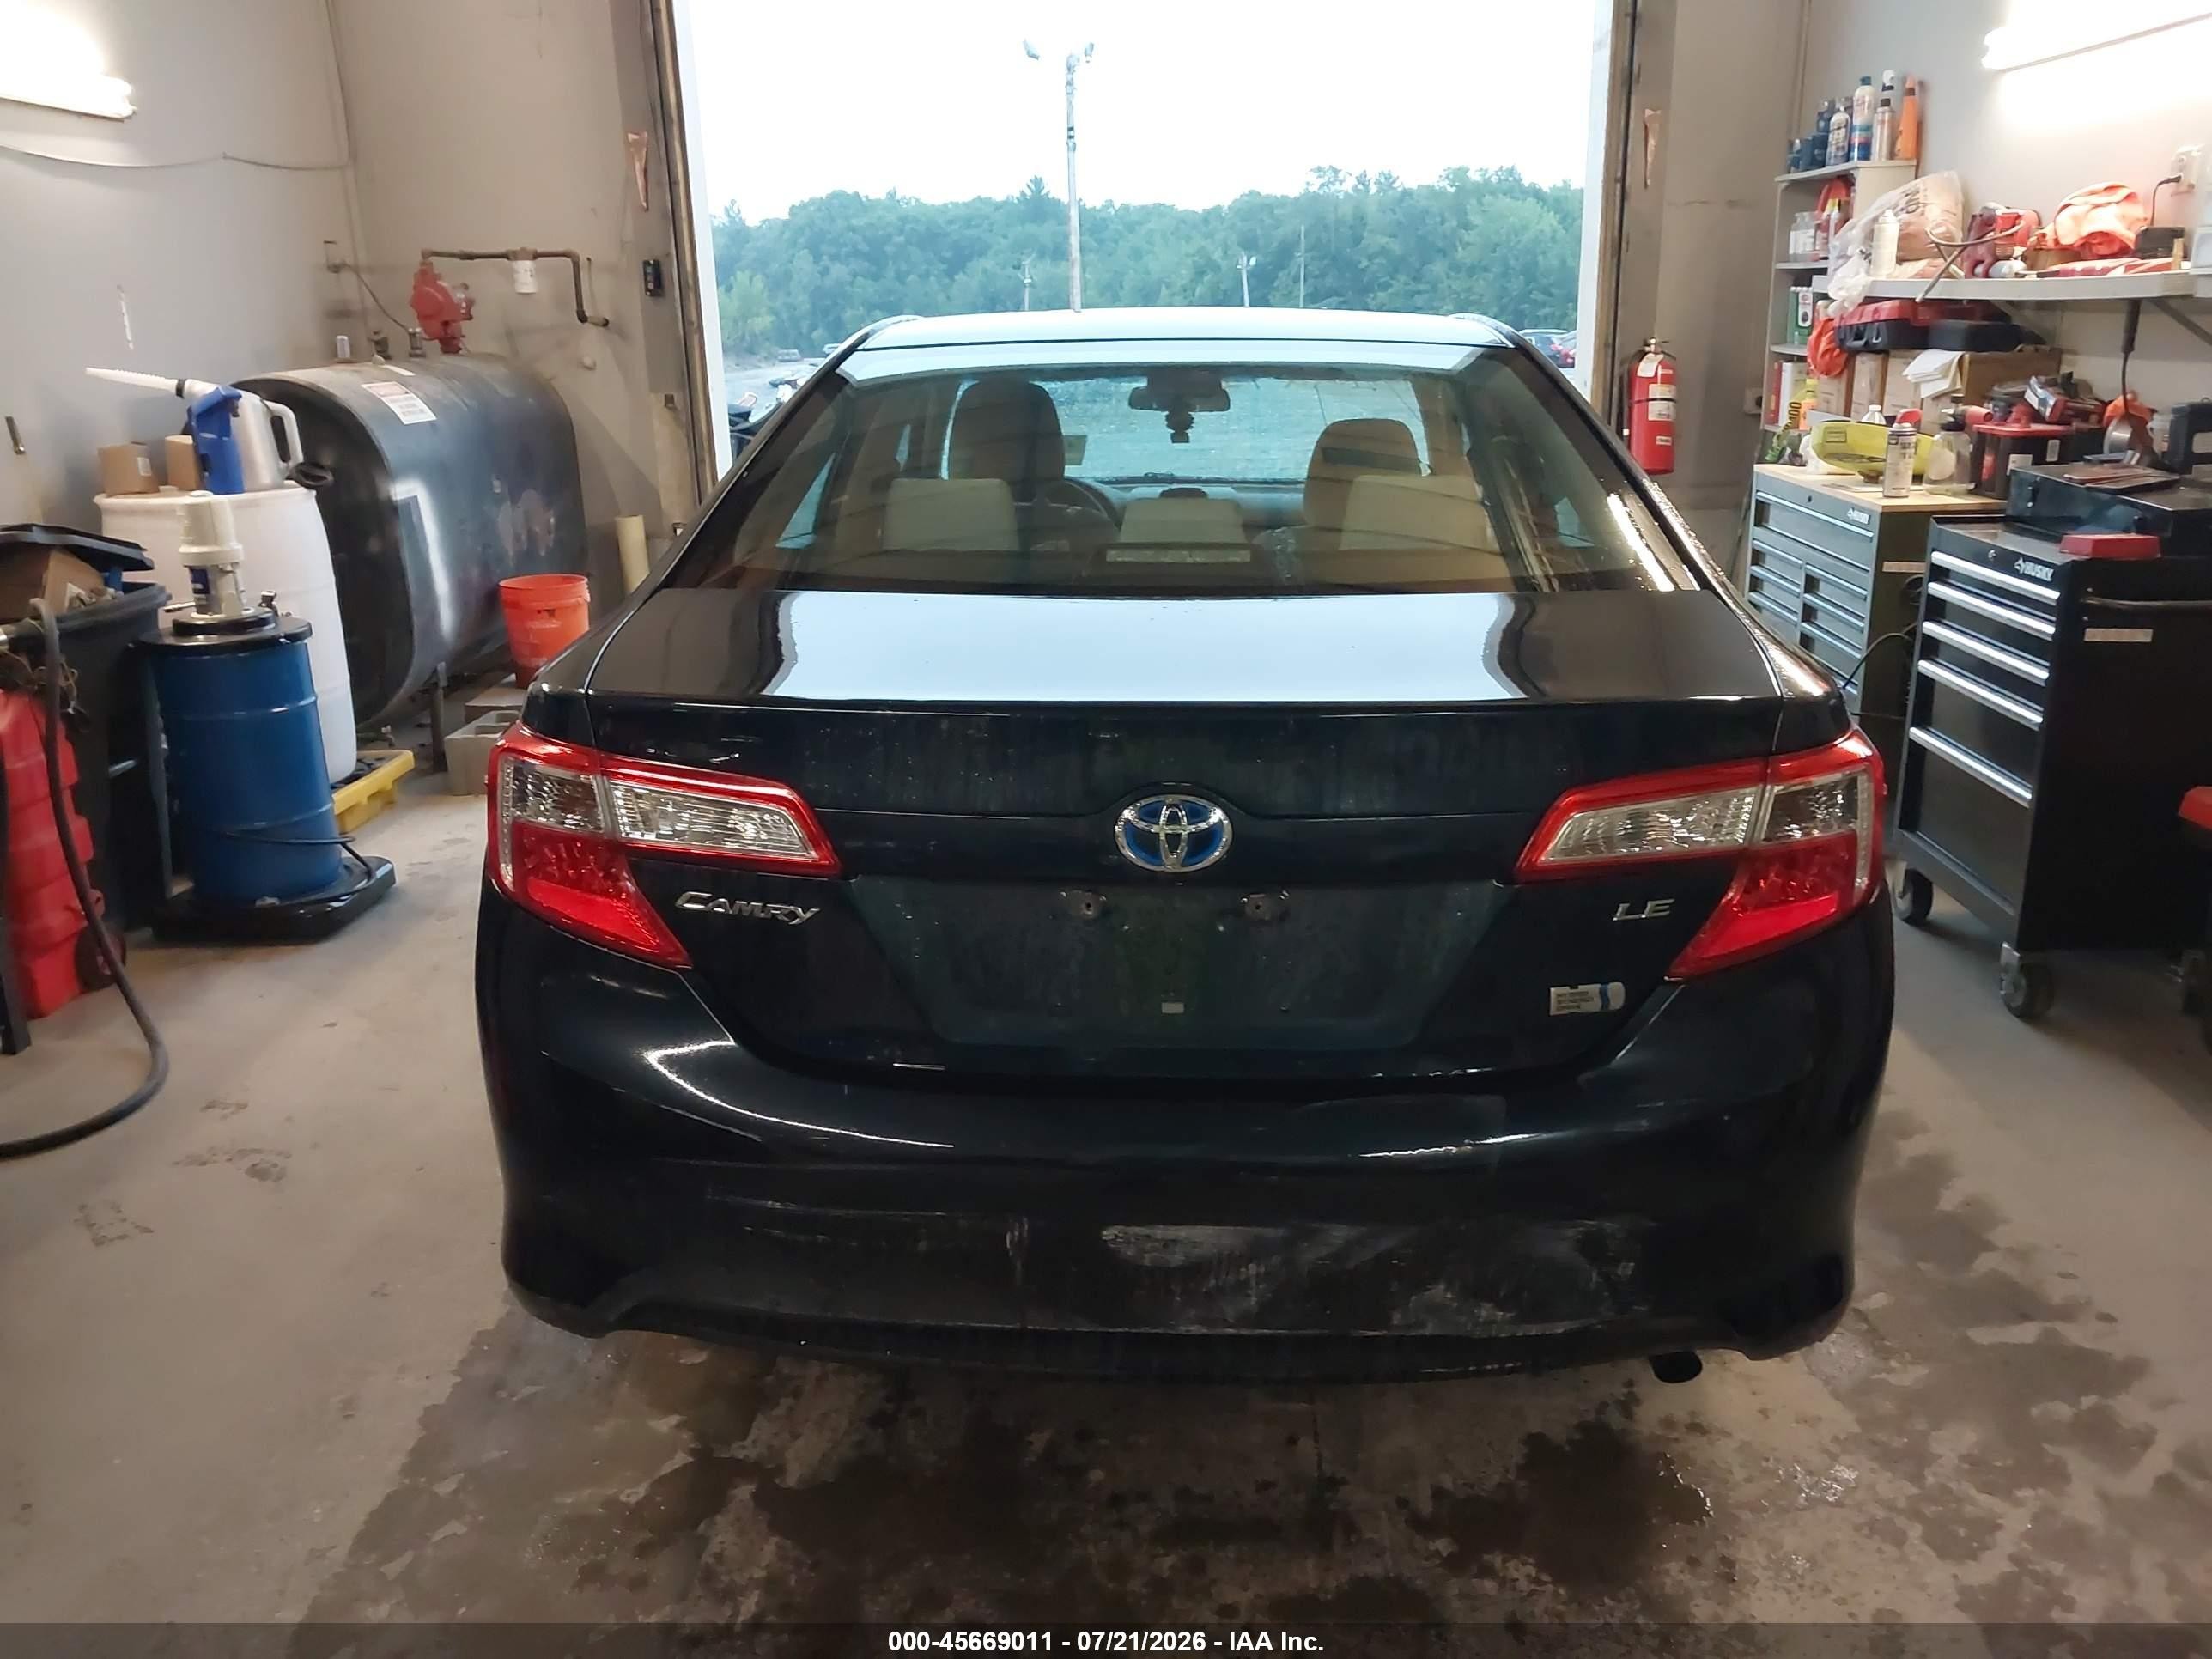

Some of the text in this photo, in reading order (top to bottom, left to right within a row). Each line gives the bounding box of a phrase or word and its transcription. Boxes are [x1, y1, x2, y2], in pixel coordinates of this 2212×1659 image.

[2024, 561, 2055, 582] HUSKY
[675, 890, 821, 925] CAMRY
[1613, 898, 1675, 921] LE
